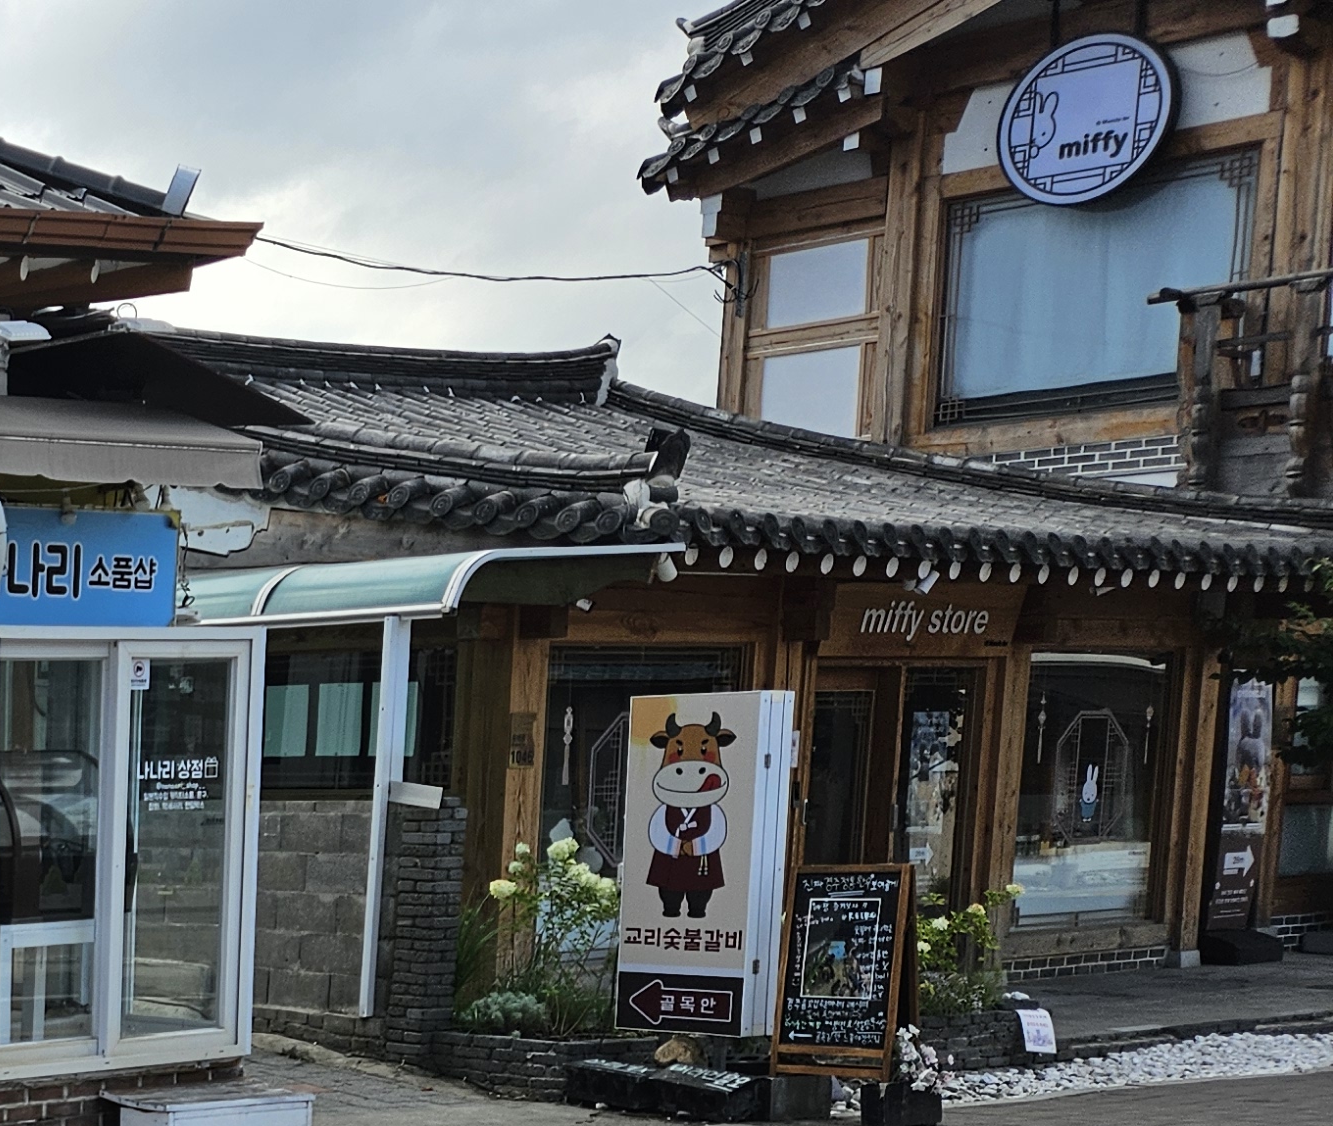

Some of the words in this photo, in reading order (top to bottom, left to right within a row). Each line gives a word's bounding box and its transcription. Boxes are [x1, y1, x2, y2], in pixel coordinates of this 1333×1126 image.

[1058, 129, 1129, 159] miffy
[2, 541, 83, 599] 나리
[87, 554, 159, 591] 소품샵
[860, 600, 925, 642] miffy
[927, 603, 990, 635] store
[177, 759, 204, 779] 상점
[623, 924, 744, 953] 교리숯불갈비
